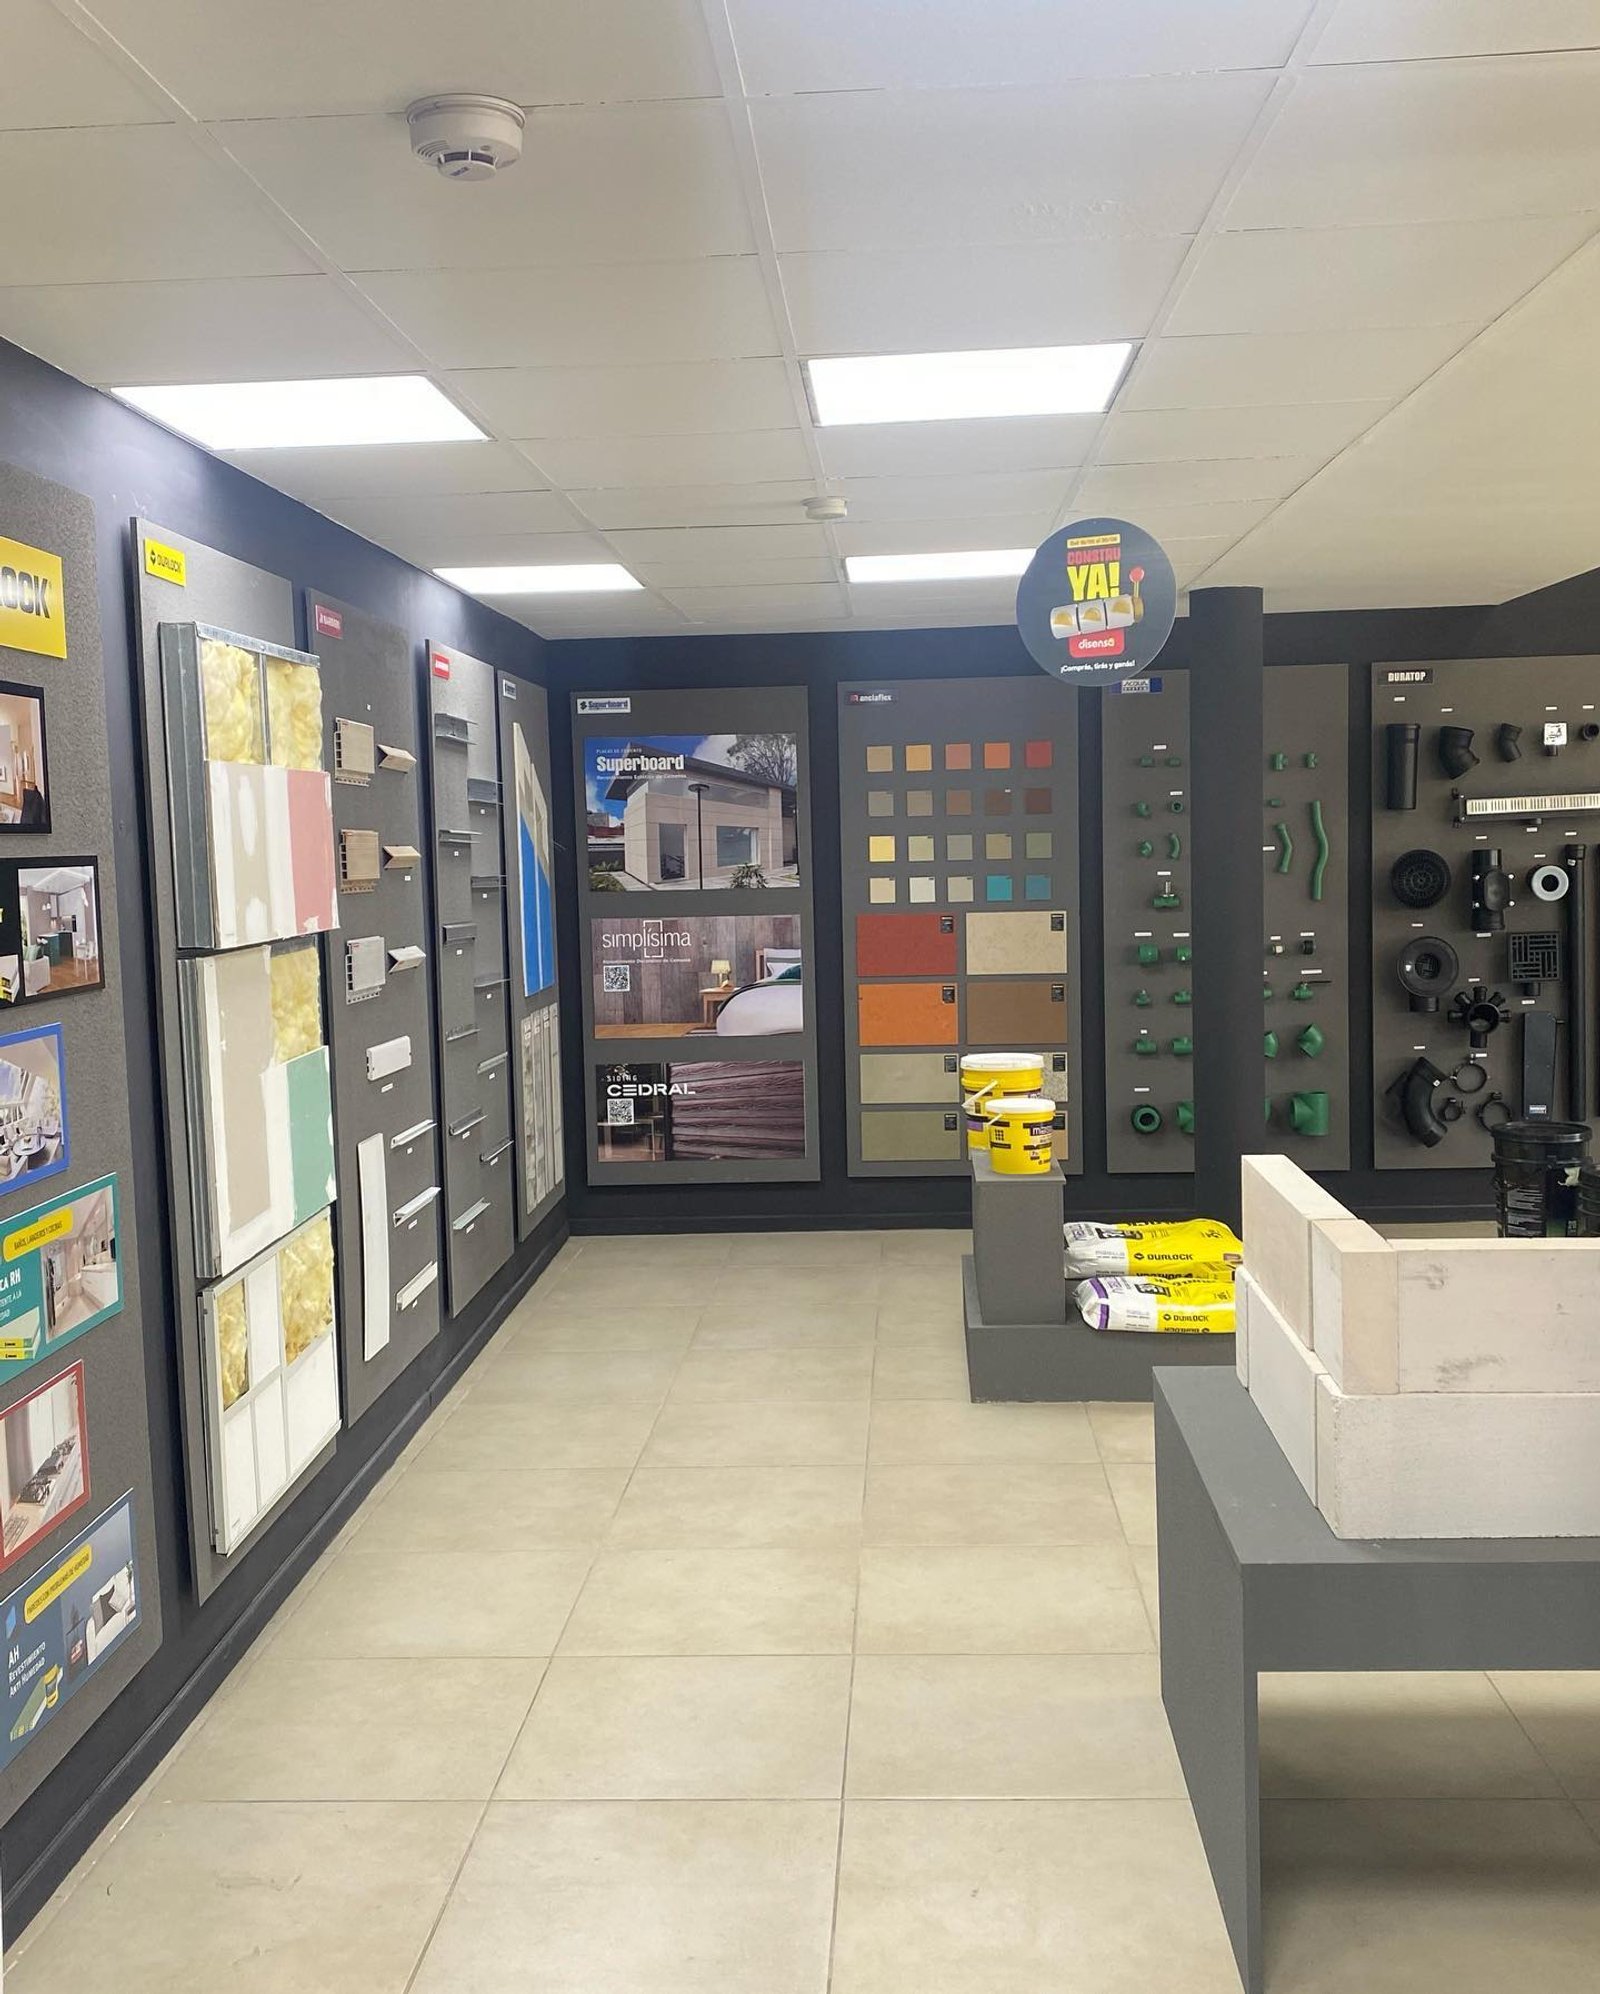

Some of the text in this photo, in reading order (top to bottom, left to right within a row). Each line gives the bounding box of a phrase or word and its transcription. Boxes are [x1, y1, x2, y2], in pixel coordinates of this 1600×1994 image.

[1067, 547, 1120, 564] CONSTRU
[1066, 562, 1120, 601] YA!
[0, 566, 50, 618] OCK
[1388, 671, 1426, 682] DURATOP
[597, 754, 684, 776] Superboard
[602, 928, 691, 951] simplísima
[607, 1083, 696, 1097] CEDRAL
[1147, 1253, 1193, 1261] DURLOCK
[10, 1267, 21, 1286] RH
[9, 1644, 20, 1669] AH
